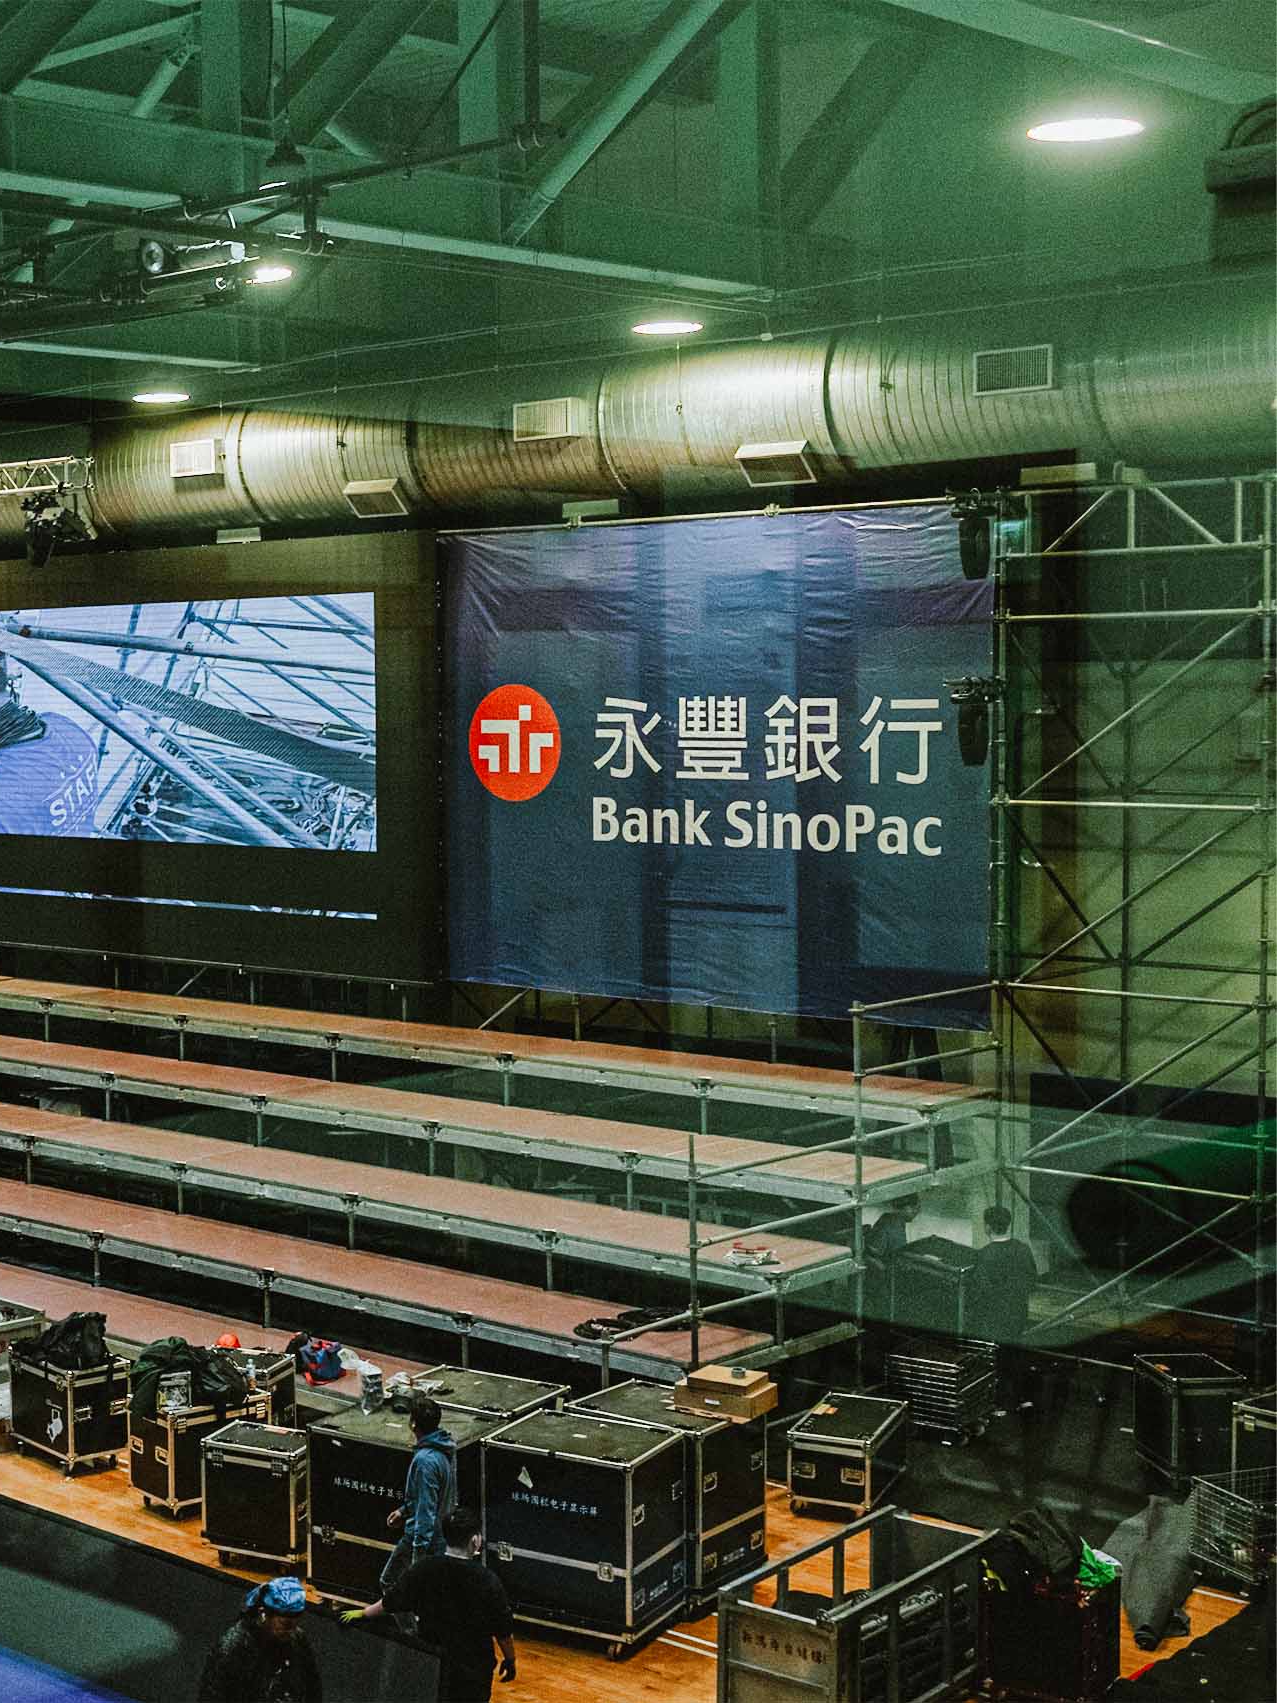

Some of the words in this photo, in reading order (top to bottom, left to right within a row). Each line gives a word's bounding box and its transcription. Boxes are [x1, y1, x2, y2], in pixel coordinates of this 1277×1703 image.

[593, 695, 943, 785] 永豐銀行
[592, 796, 713, 847] Bank
[724, 799, 943, 857] SinoPac
